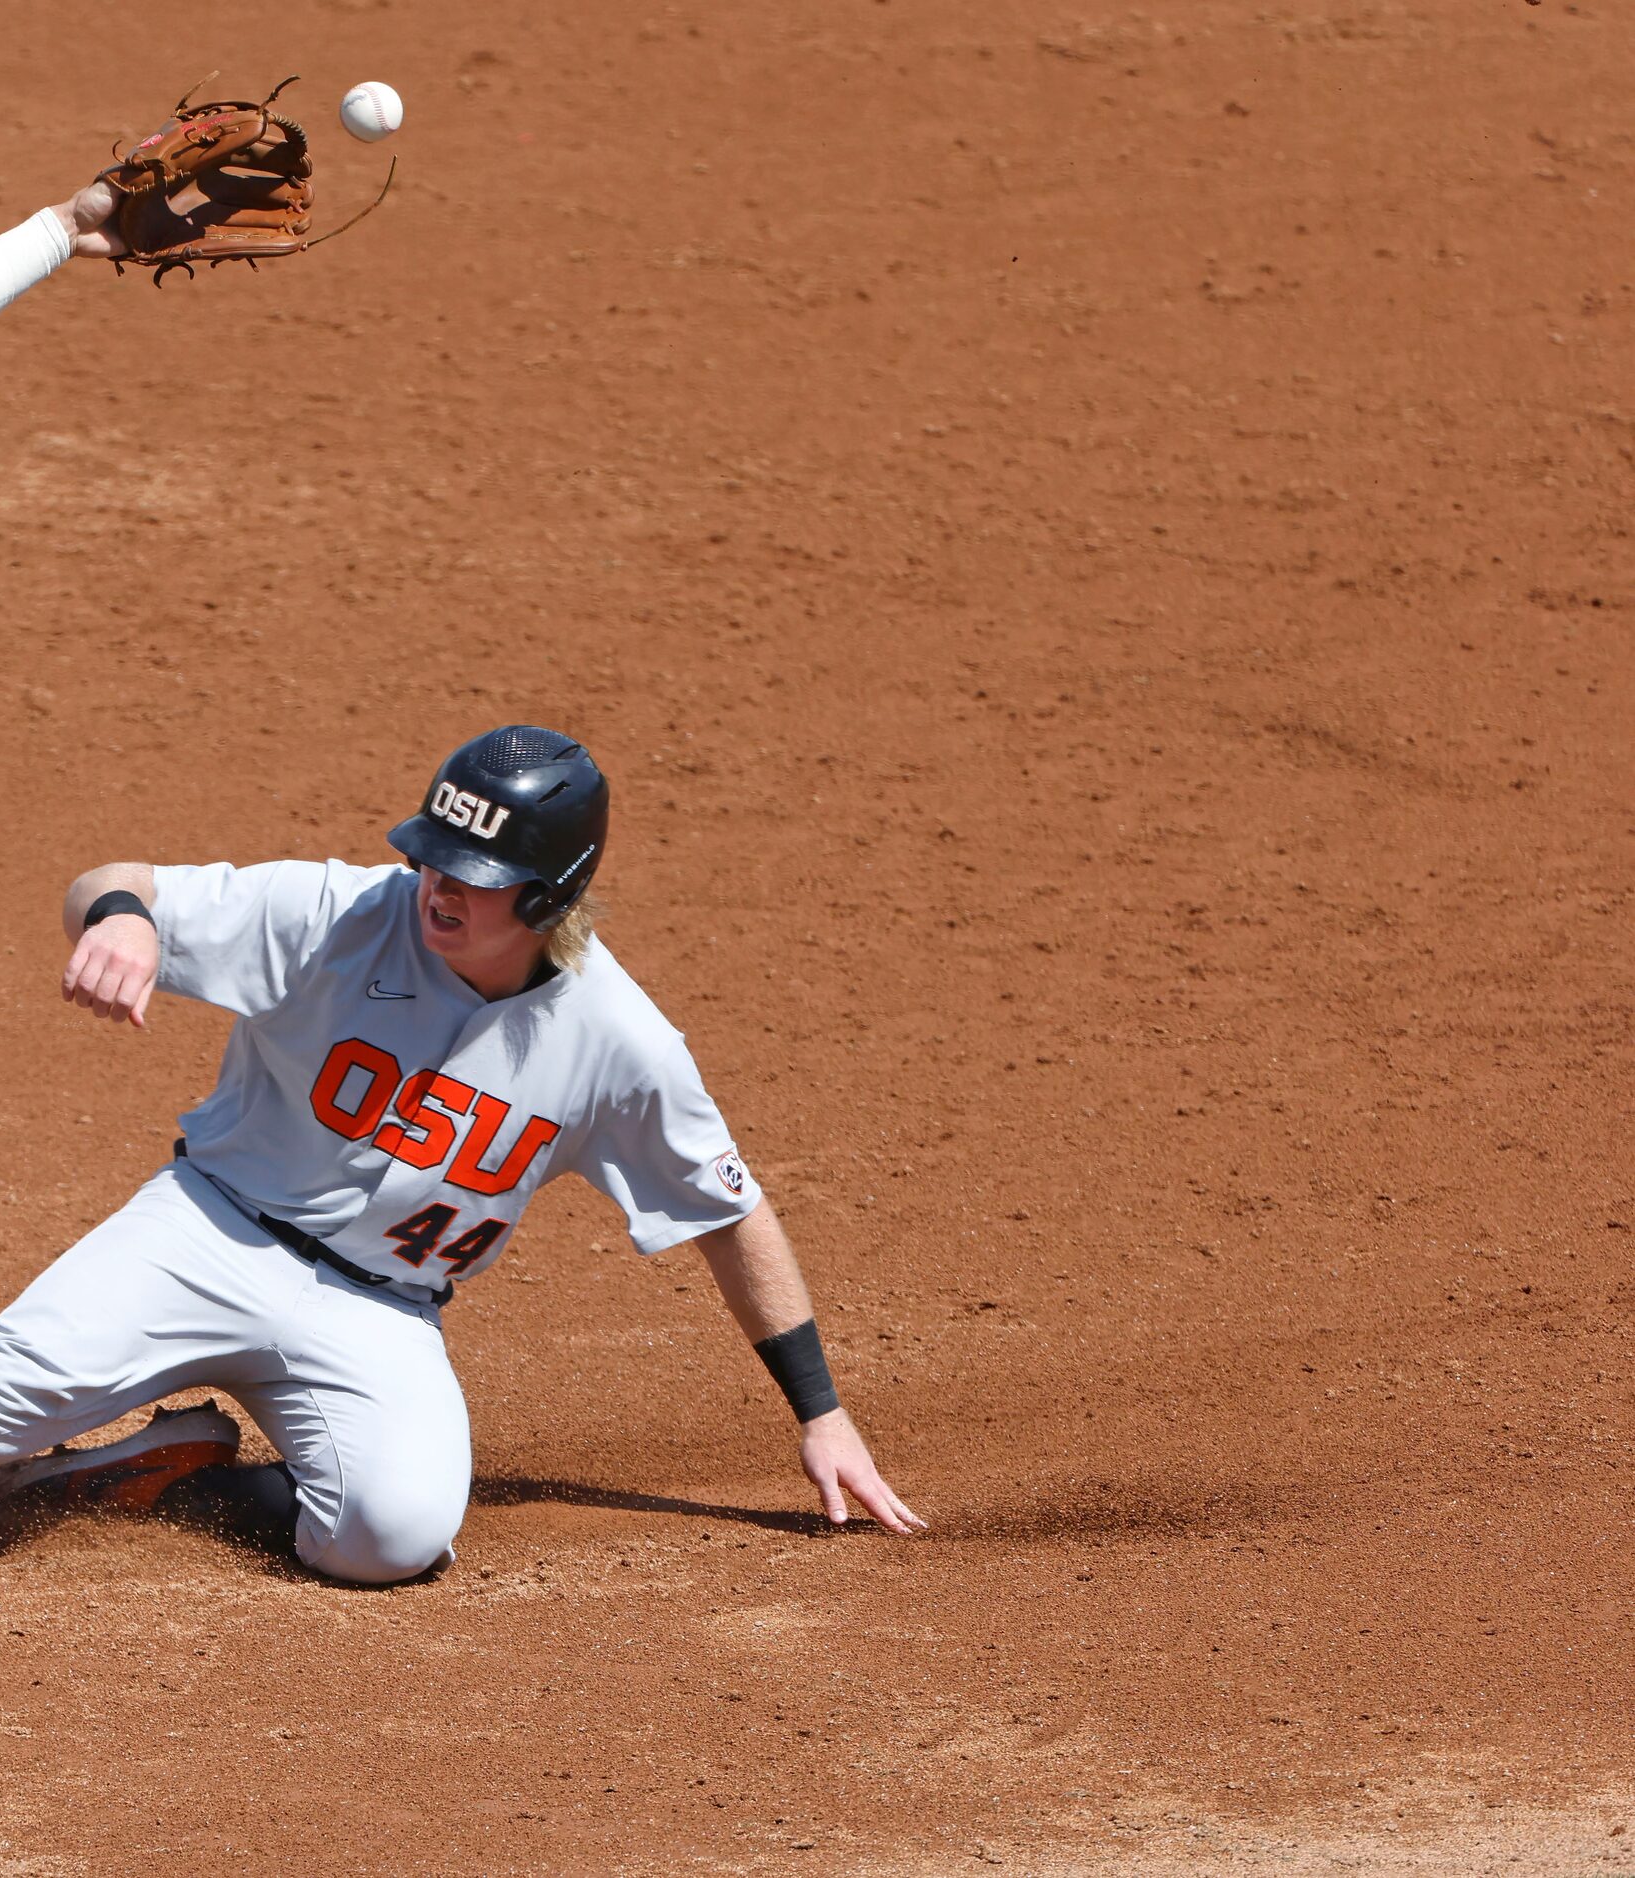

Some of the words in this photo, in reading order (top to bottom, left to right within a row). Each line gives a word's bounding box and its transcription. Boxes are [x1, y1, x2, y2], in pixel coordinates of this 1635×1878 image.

[430, 781, 511, 840] OSU
[309, 1037, 561, 1196] OSU
[383, 1202, 510, 1276] 44
